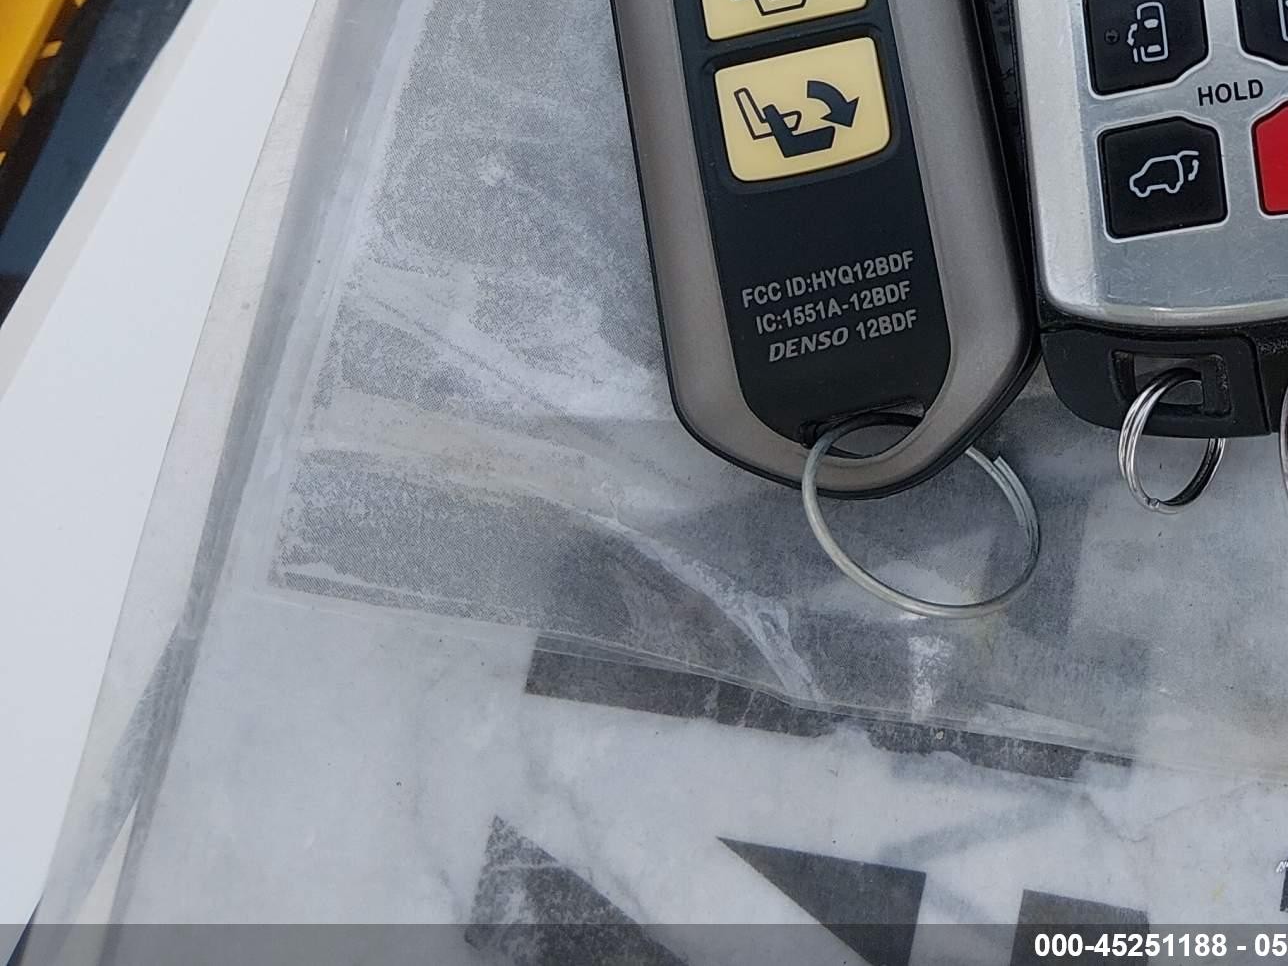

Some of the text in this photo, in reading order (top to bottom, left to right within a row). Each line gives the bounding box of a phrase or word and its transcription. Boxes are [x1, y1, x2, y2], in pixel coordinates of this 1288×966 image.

[1197, 79, 1264, 107] HOLD
[741, 250, 914, 308] FCC ID:HYQ12BDF
[756, 280, 911, 334] IC:1551A-12BDF
[768, 308, 918, 362] DENSO 12BDF
